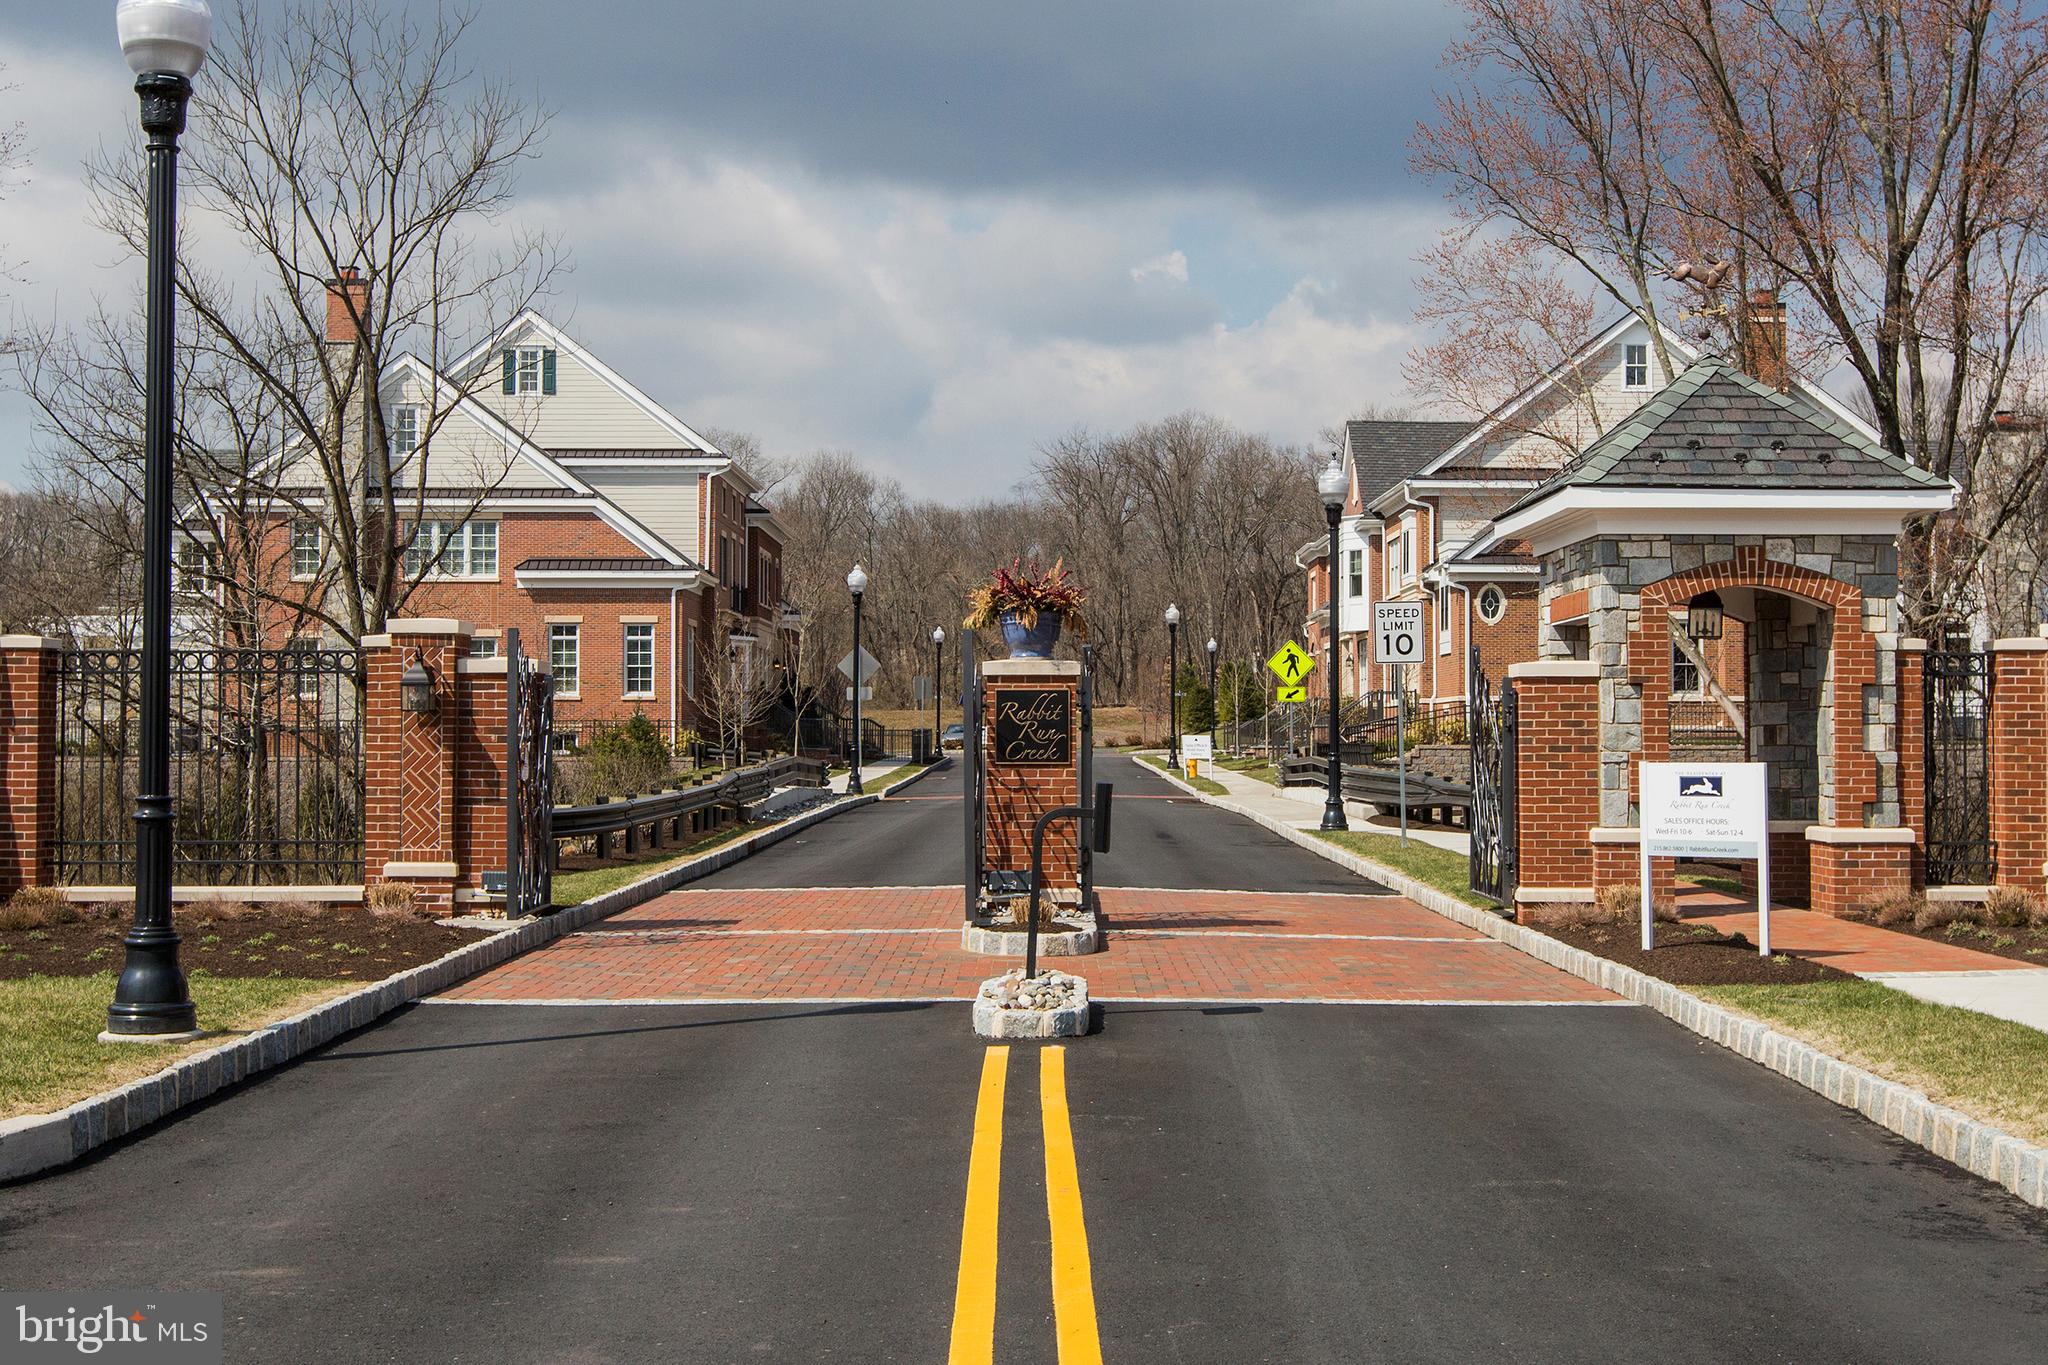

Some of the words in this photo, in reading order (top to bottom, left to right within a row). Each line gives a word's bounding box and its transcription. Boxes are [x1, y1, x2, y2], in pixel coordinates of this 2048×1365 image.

[1378, 608, 1419, 618] SPEED
[1383, 621, 1414, 631] LIMIT
[1383, 633, 1413, 655] 10
[999, 693, 1063, 725] Rabbit
[1018, 720, 1060, 744] Run
[1006, 734, 1067, 760] Creek
[1670, 800, 1692, 810] Rabbit
[1695, 800, 1709, 810] Run
[1680, 828, 1693, 836] 10-6
